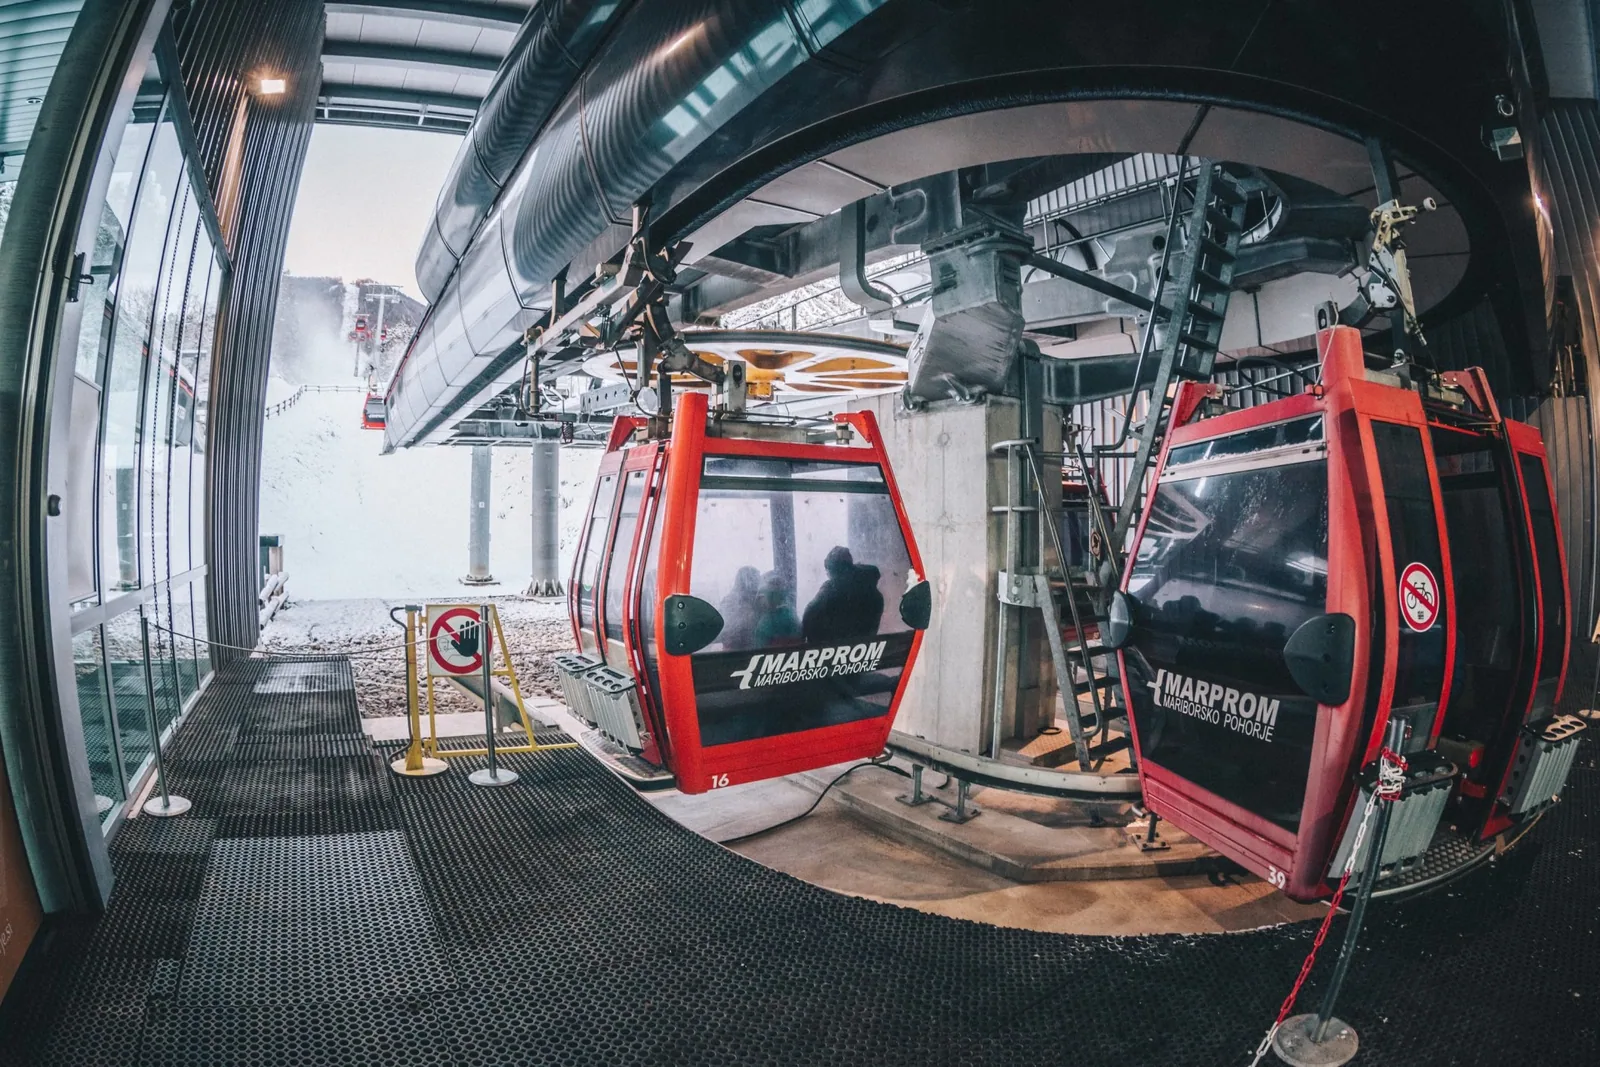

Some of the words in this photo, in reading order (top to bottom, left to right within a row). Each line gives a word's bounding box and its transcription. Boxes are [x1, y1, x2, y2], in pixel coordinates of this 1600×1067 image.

[753, 665, 828, 688] MARIBORSKO
[831, 658, 880, 677] POHORJE
[759, 641, 887, 675] MARPROM
[1164, 671, 1280, 727] MARPROM
[1162, 694, 1220, 725] MARIBORSKO
[1223, 713, 1275, 743] POHORJE
[711, 773, 730, 789] 16
[1267, 864, 1287, 890] 39
